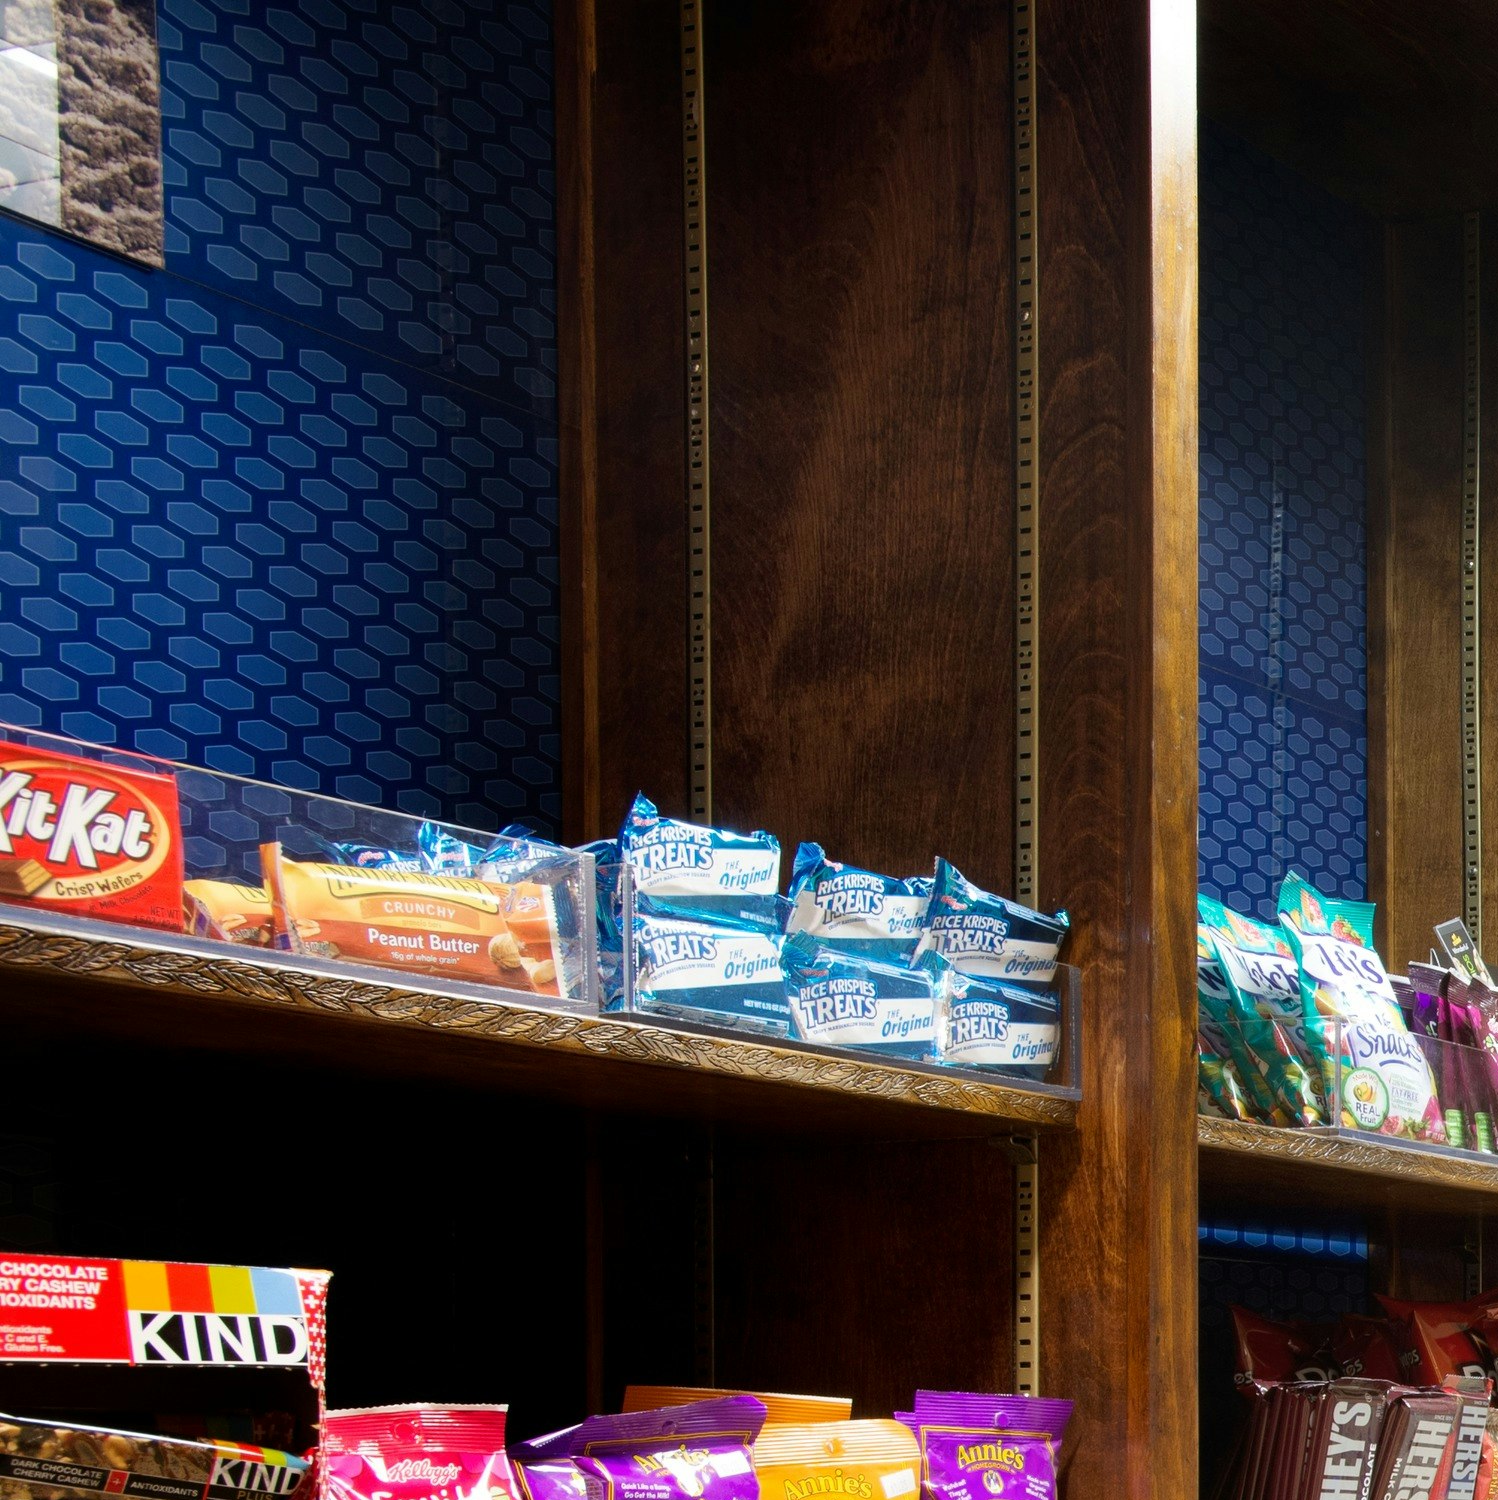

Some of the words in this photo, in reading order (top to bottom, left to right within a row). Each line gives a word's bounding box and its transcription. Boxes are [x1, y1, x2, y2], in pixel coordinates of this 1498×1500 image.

[631, 843, 714, 880] TREATS
[55, 880, 94, 898] Crisp
[97, 871, 144, 894] Wafers
[719, 862, 775, 890] Original
[844, 873, 885, 893] KRISPIES
[384, 901, 456, 920] CRUNCHY
[817, 890, 884, 924] TREATS
[964, 914, 1008, 934] KRISPIES
[368, 928, 425, 950] Peanut
[430, 933, 480, 954] Butter
[829, 979, 876, 998] KRISPIES
[802, 996, 877, 1030] TREATS
[1355, 1103, 1381, 1117] REAL
[1360, 1113, 1377, 1125] Fruit
[1, 1260, 108, 1281] CHOCOLATE
[25, 1278, 100, 1295] CASHEW
[130, 1312, 308, 1364] KIND
[957, 1440, 1025, 1471] Annie's
[210, 1456, 305, 1495] KIND
[388, 1458, 462, 1486] Kellogg's
[130, 1480, 199, 1498] ANTIOXIDANTS
